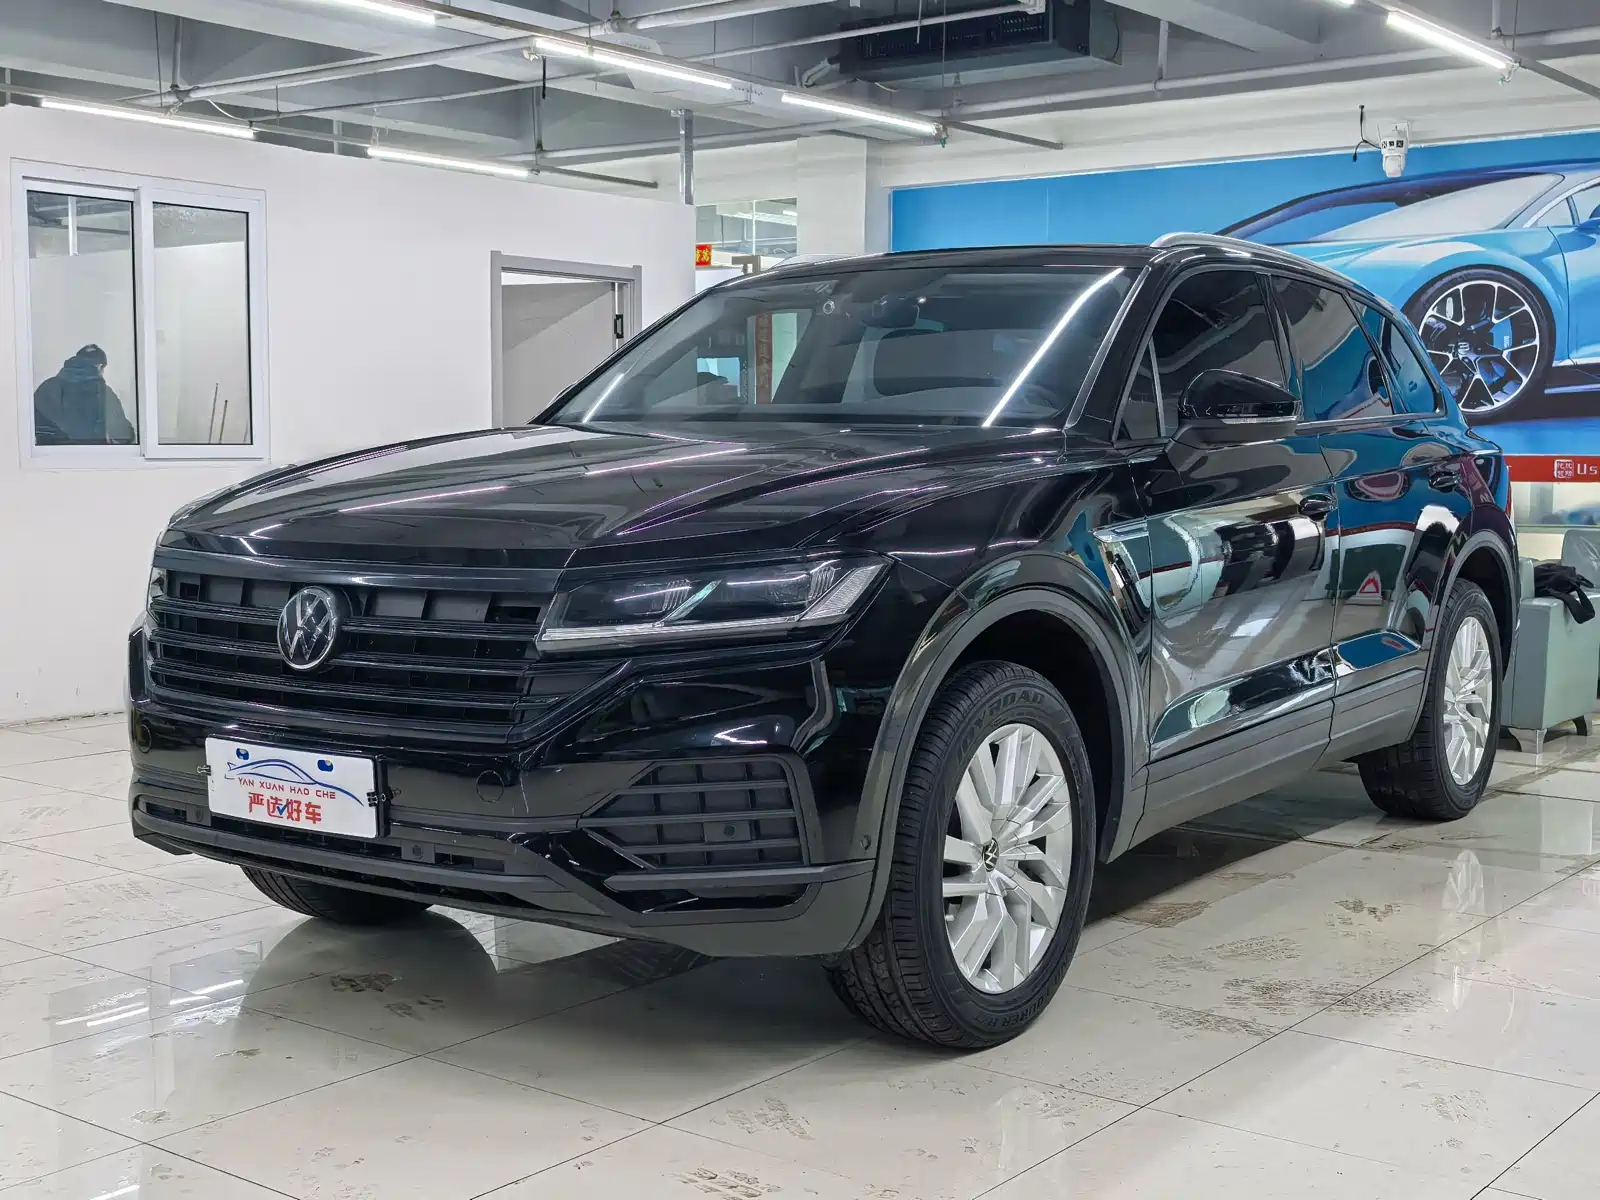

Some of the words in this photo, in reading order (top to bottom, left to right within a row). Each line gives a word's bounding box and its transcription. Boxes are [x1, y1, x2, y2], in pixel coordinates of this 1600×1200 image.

[237, 777, 255, 787] YAN
[259, 782, 285, 791] XUAN
[289, 786, 310, 796] HAO
[315, 789, 336, 799] CHE
[248, 792, 322, 824] 严选好车
